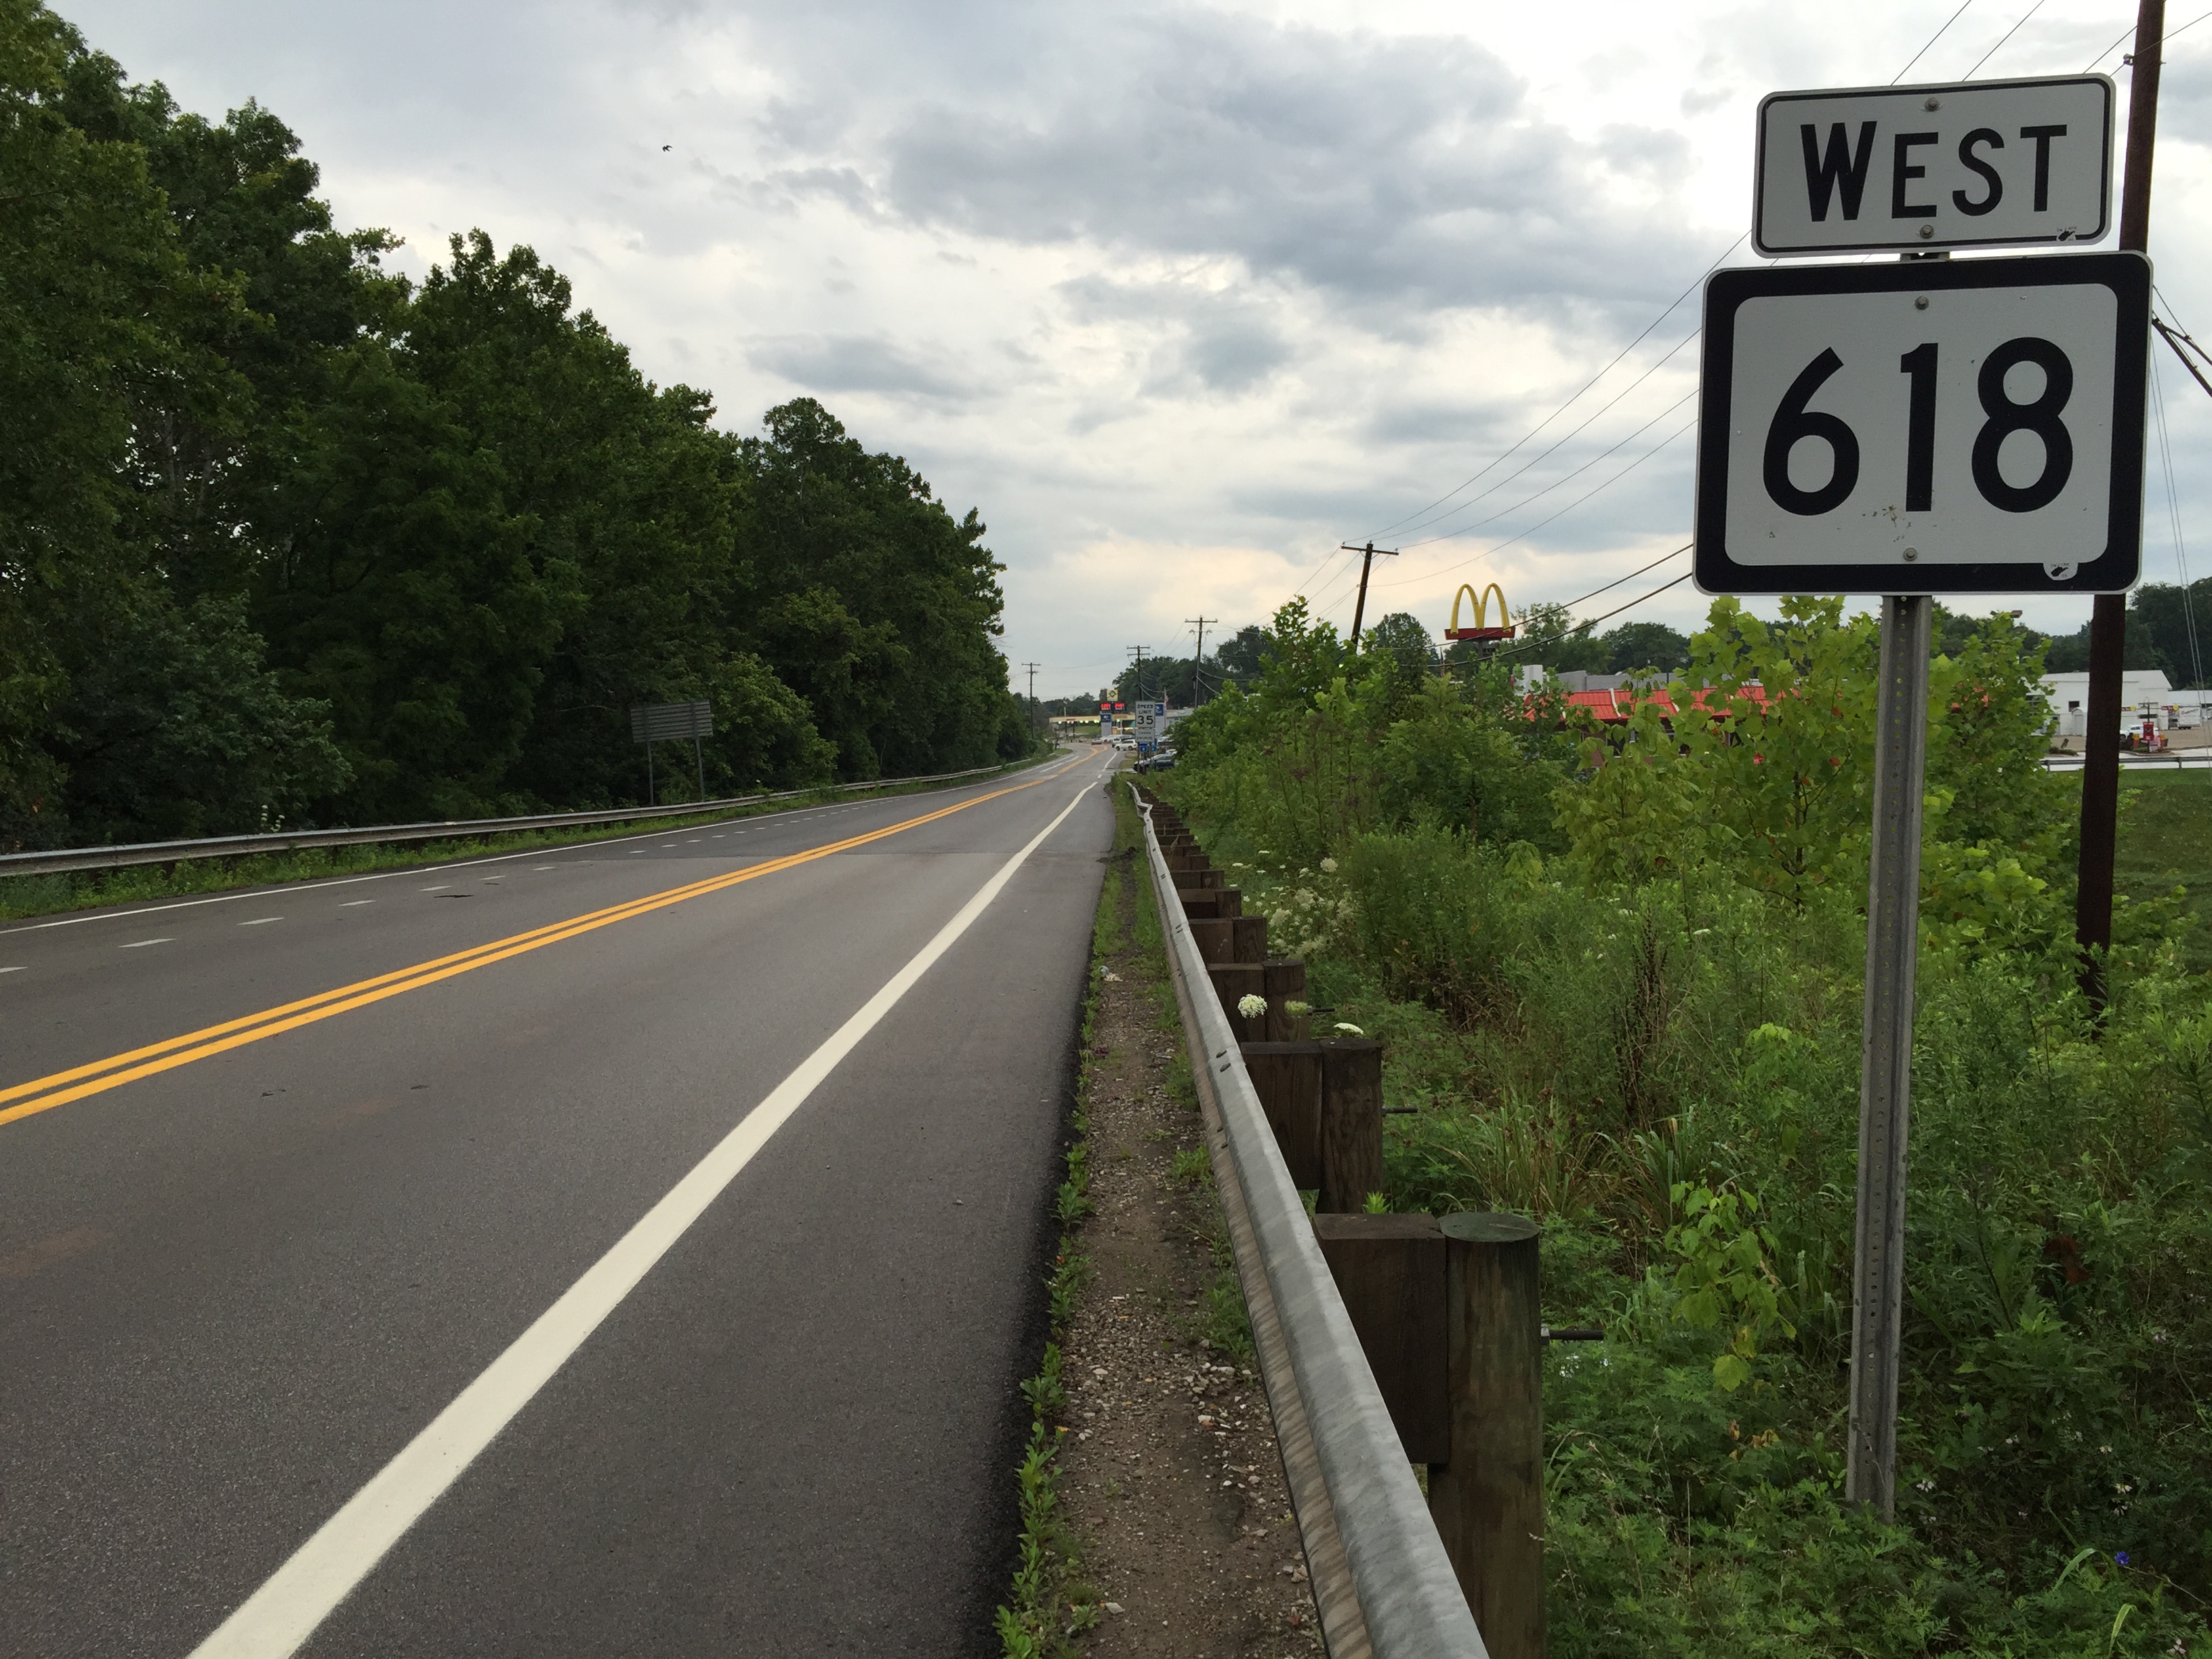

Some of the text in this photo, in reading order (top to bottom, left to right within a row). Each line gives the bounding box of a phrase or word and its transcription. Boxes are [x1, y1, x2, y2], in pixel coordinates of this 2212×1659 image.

[1800, 121, 2068, 222] WEST
[1763, 337, 2074, 516] 618
[1137, 715, 1153, 724] 35
